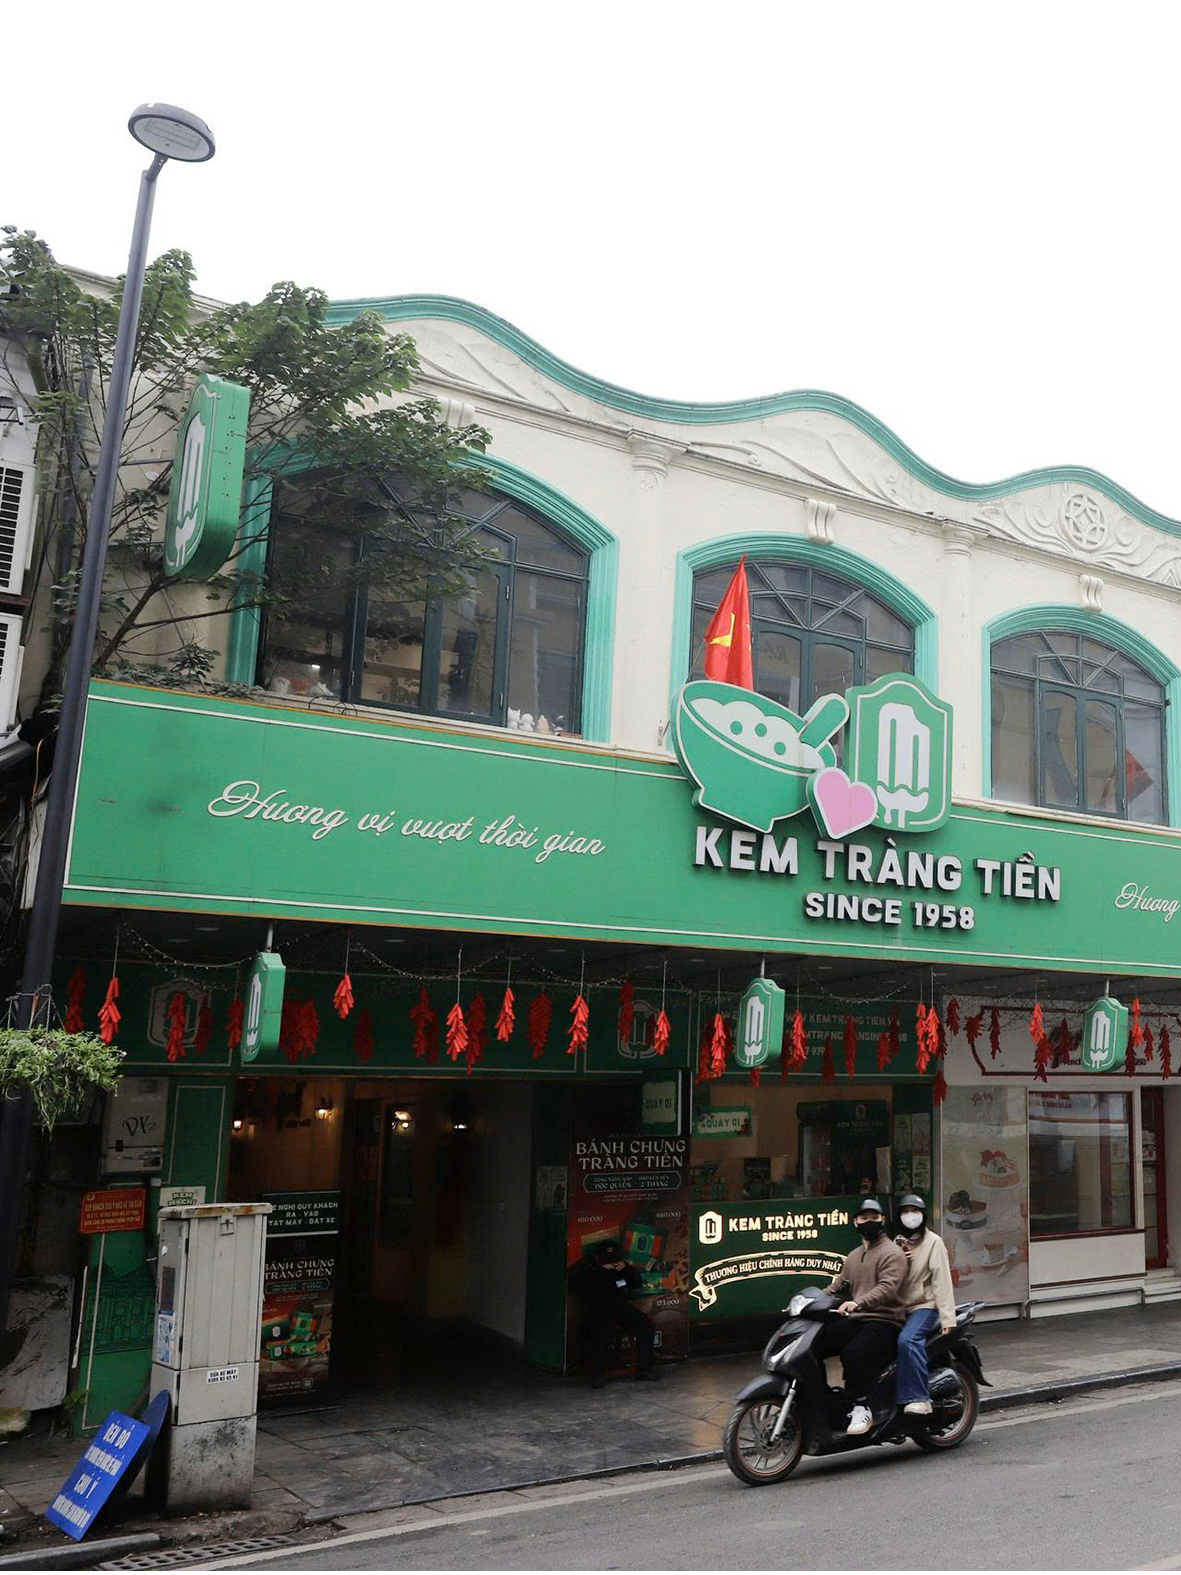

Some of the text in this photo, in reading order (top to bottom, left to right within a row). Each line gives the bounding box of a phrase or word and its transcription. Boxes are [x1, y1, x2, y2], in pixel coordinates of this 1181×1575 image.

[357, 811, 396, 837] vị
[479, 815, 538, 848] thời
[535, 831, 605, 863] gian
[694, 826, 1062, 902] KEM TRÀNG TIỀN
[804, 892, 976, 930] SINCE 1958
[576, 1138, 686, 1155] BÁNH CHƯNG
[579, 1151, 684, 1170] TRÀNG TIỀN
[728, 1209, 849, 1232] KEM TRÀNG TIỀN
[762, 1229, 818, 1242] SINCE 1958
[806, 1257, 822, 1269] DUY
